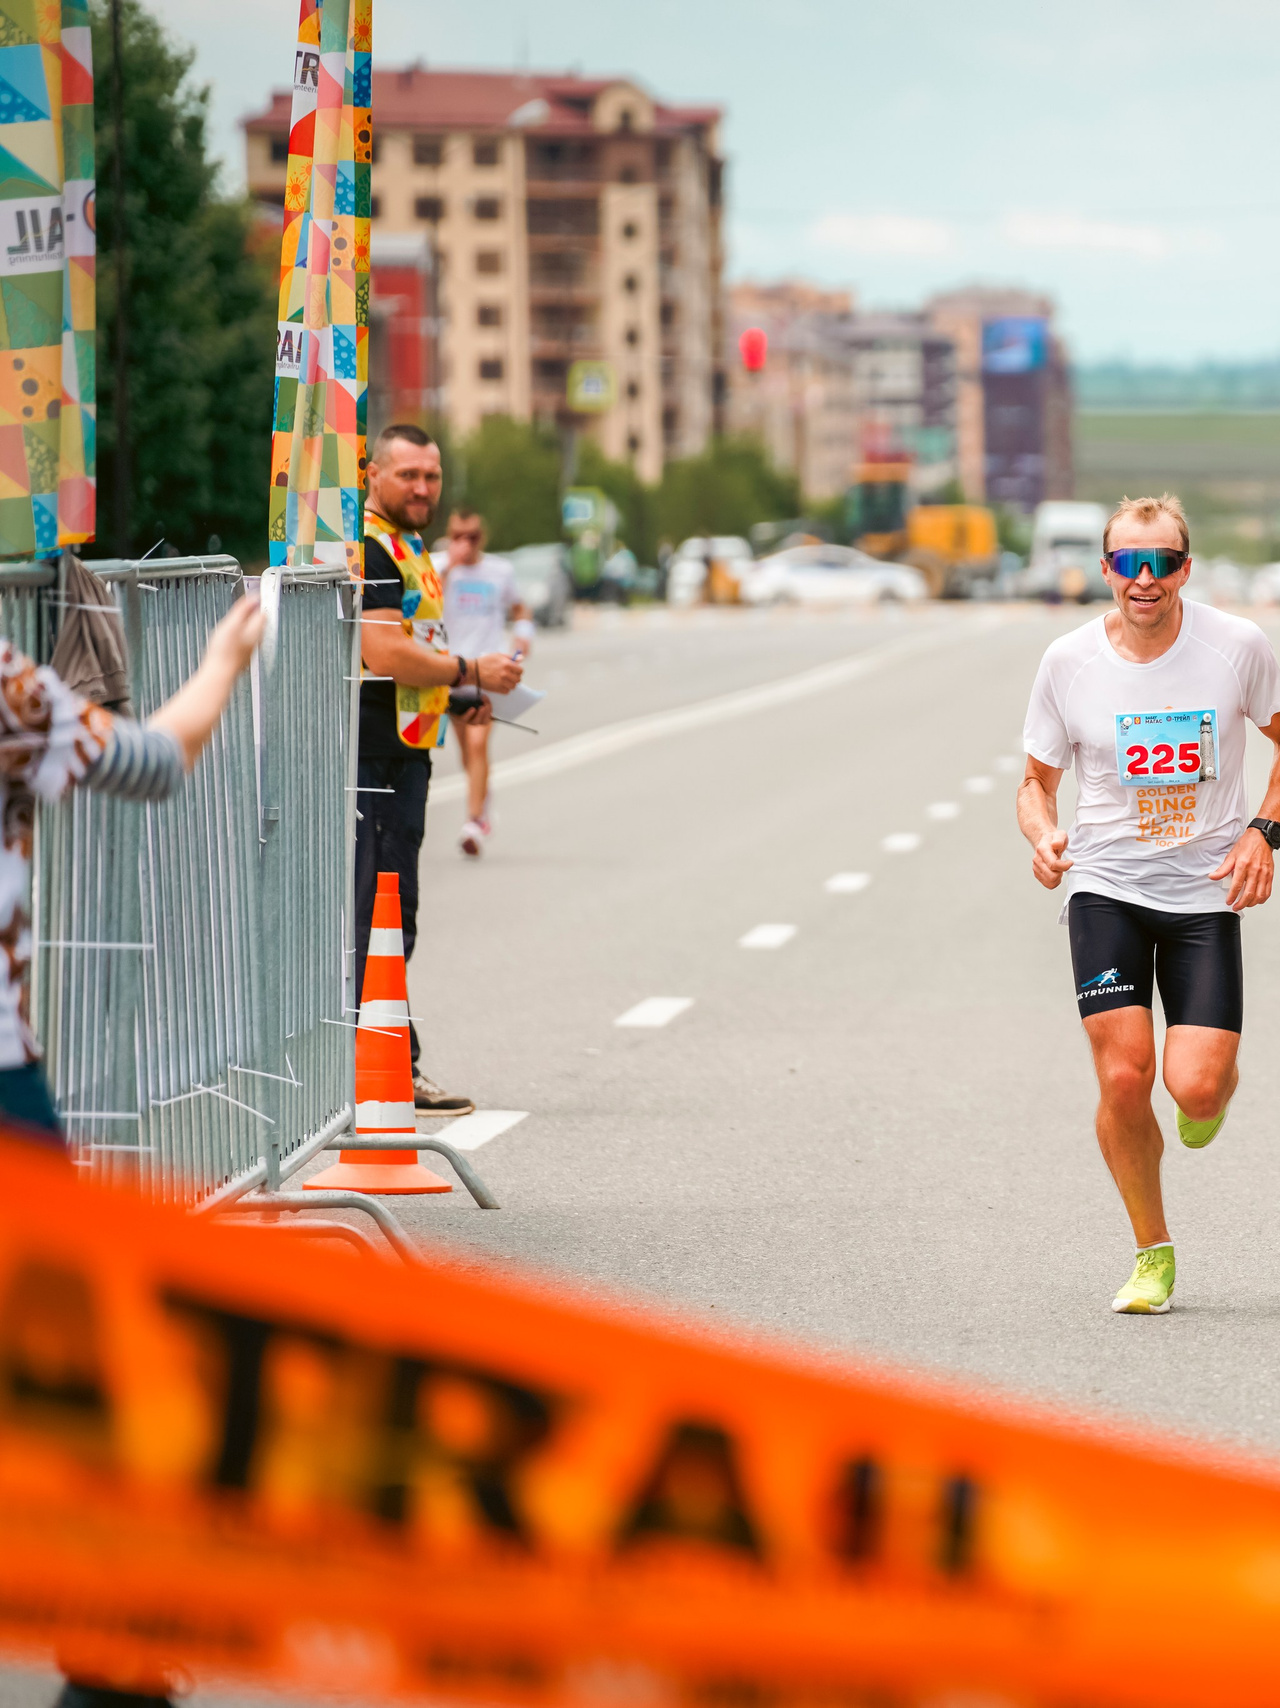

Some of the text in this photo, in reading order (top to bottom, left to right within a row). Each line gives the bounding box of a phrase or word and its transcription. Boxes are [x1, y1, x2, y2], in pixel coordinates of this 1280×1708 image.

[1126, 743, 1200, 775] 225
[1136, 783, 1196, 797] GOLDEN
[1138, 795, 1197, 814] RING
[1139, 812, 1196, 827] ULTRA
[1138, 825, 1195, 838] TRAIL
